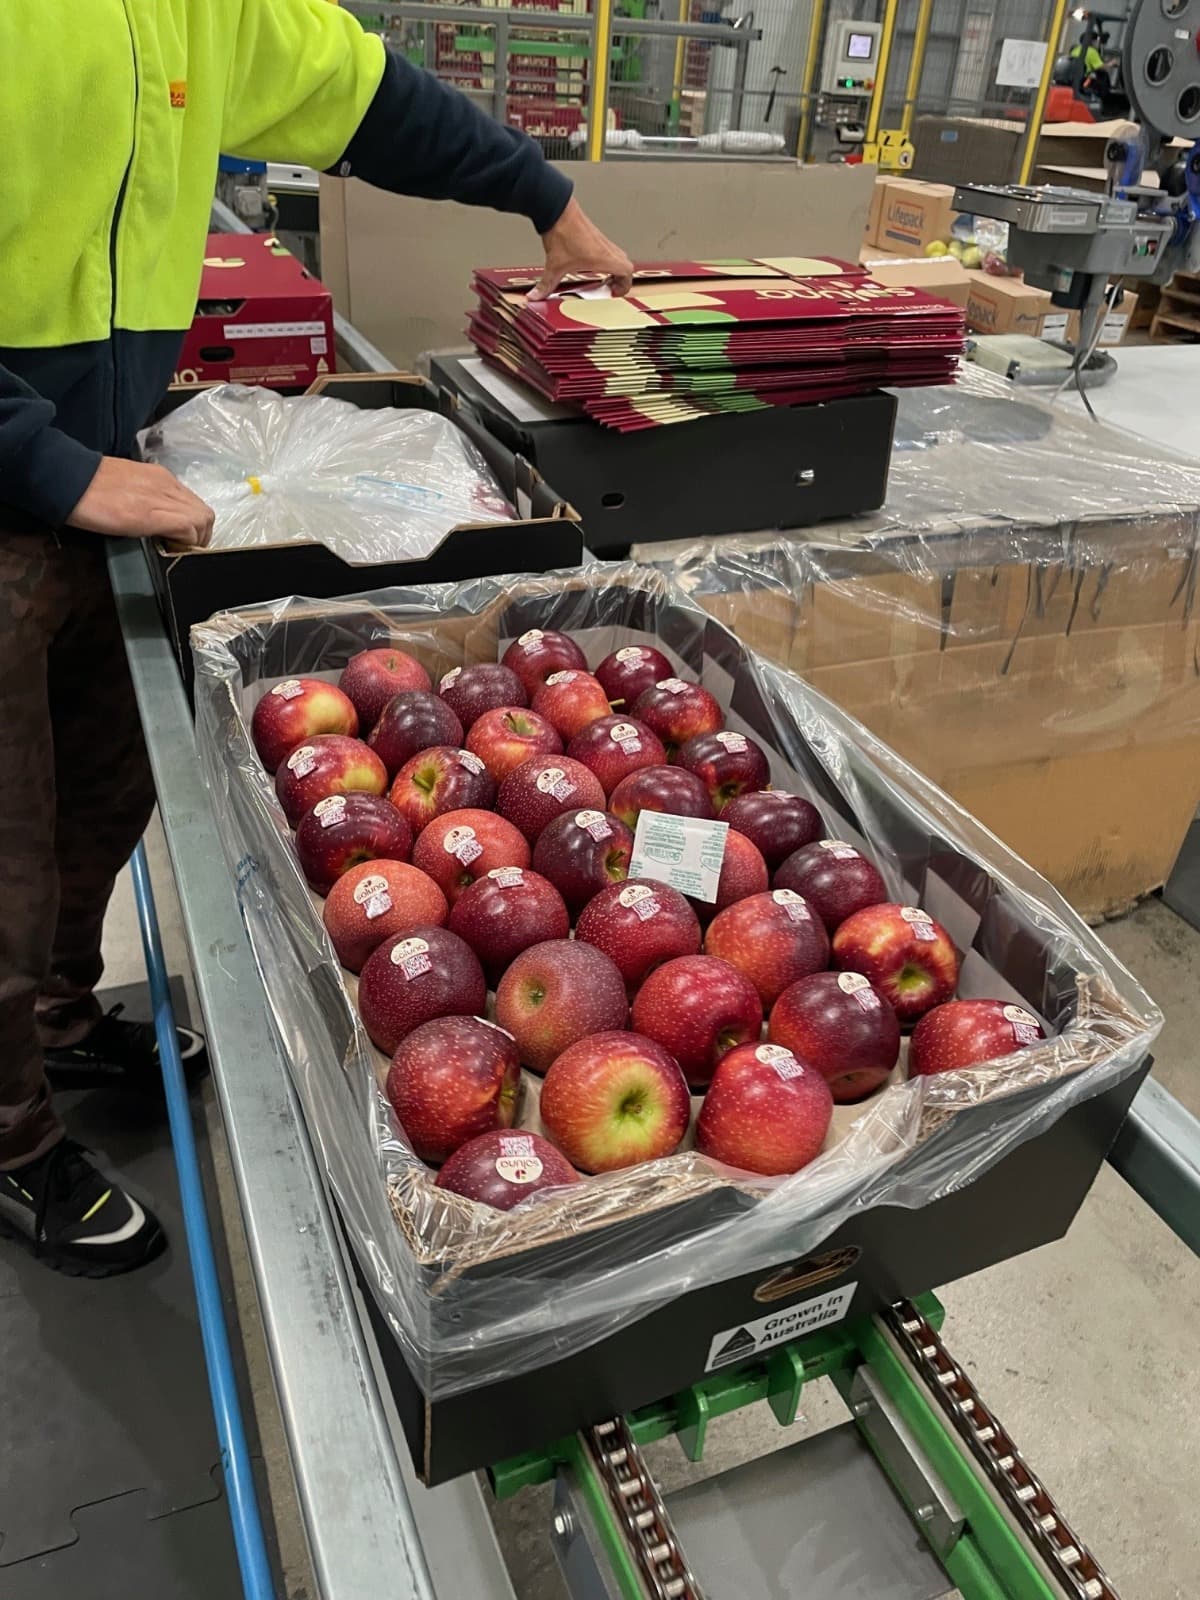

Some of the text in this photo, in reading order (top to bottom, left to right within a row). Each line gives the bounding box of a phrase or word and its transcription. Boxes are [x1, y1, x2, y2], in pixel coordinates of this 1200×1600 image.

[357, 882, 386, 902] soluna
[500, 1159, 539, 1170] soluna
[759, 1308, 838, 1345] Australia
[763, 1295, 844, 1331] Grown in
